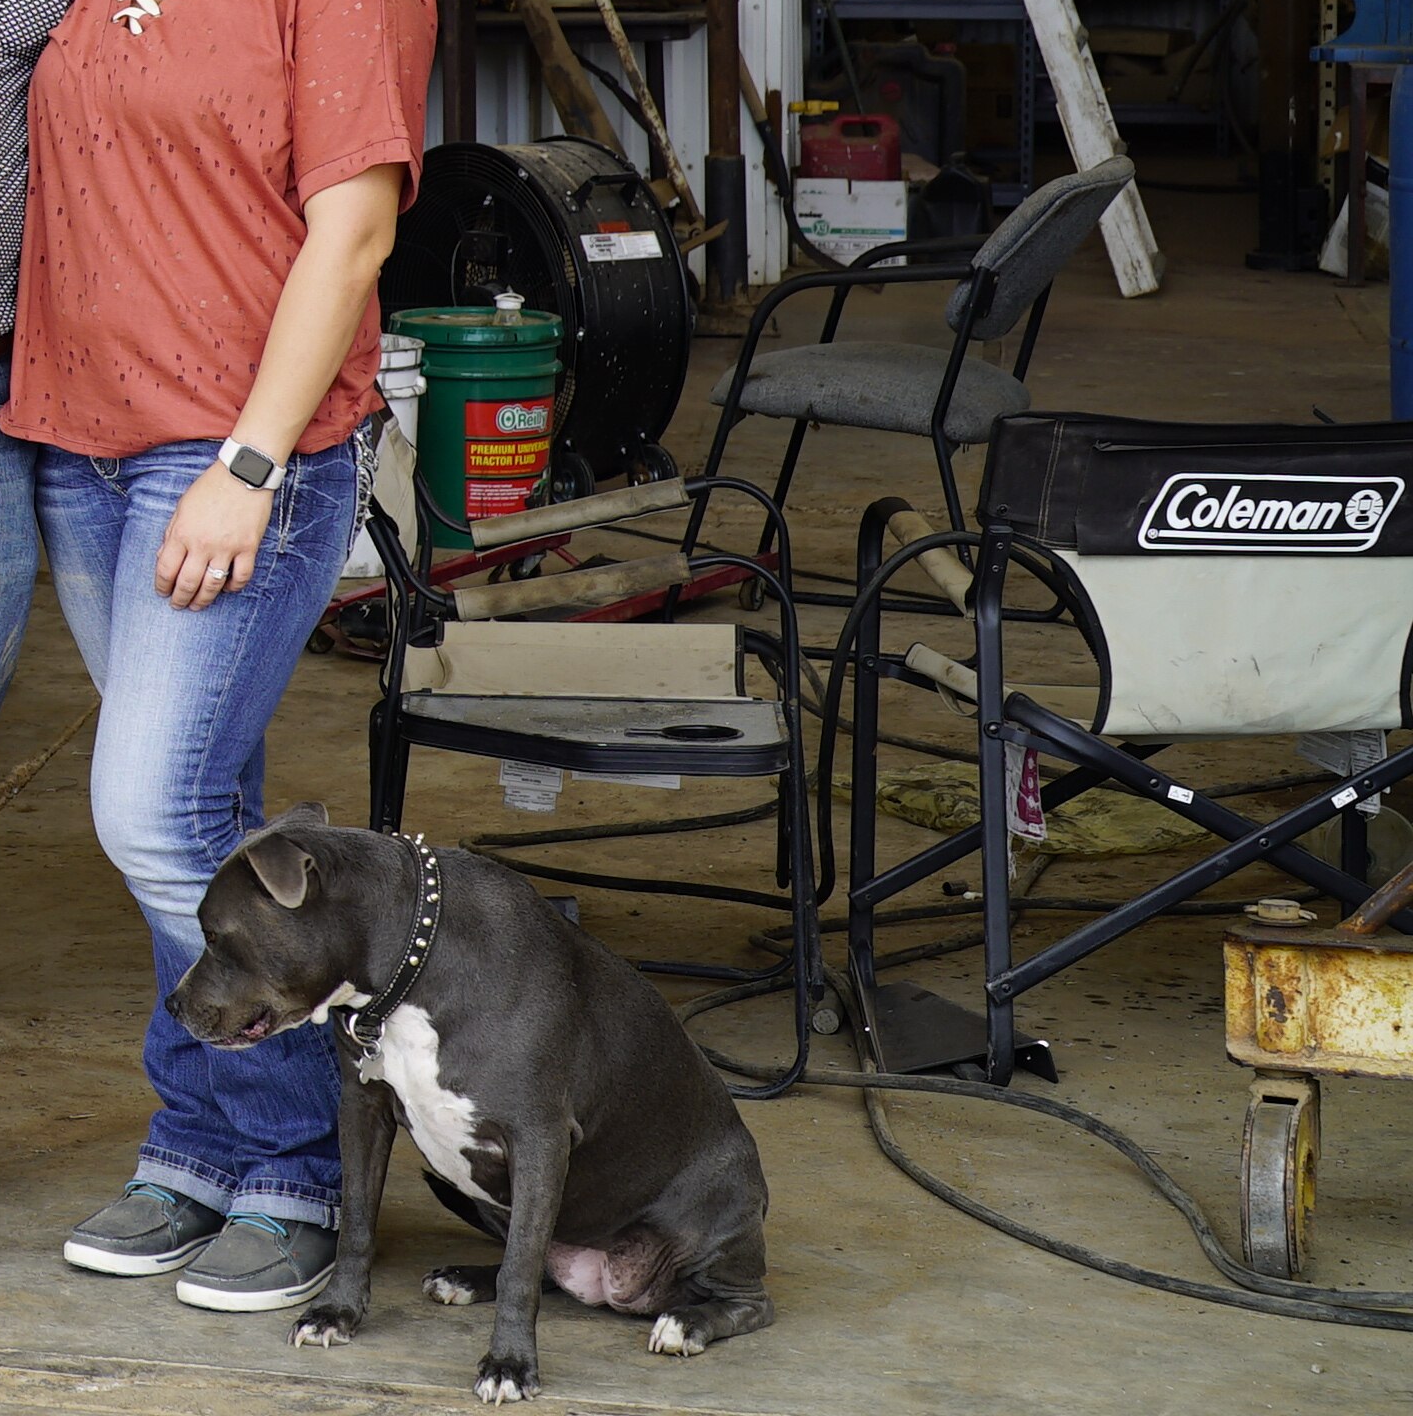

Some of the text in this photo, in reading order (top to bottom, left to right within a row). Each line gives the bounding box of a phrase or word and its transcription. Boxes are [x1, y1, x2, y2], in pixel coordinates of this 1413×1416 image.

[497, 404, 549, 433] O'Reilly
[470, 440, 550, 455] PREMIUM UNIVERSA
[470, 454, 536, 466] TRACTOR FLUID
[1166, 484, 1343, 530] Coleman
